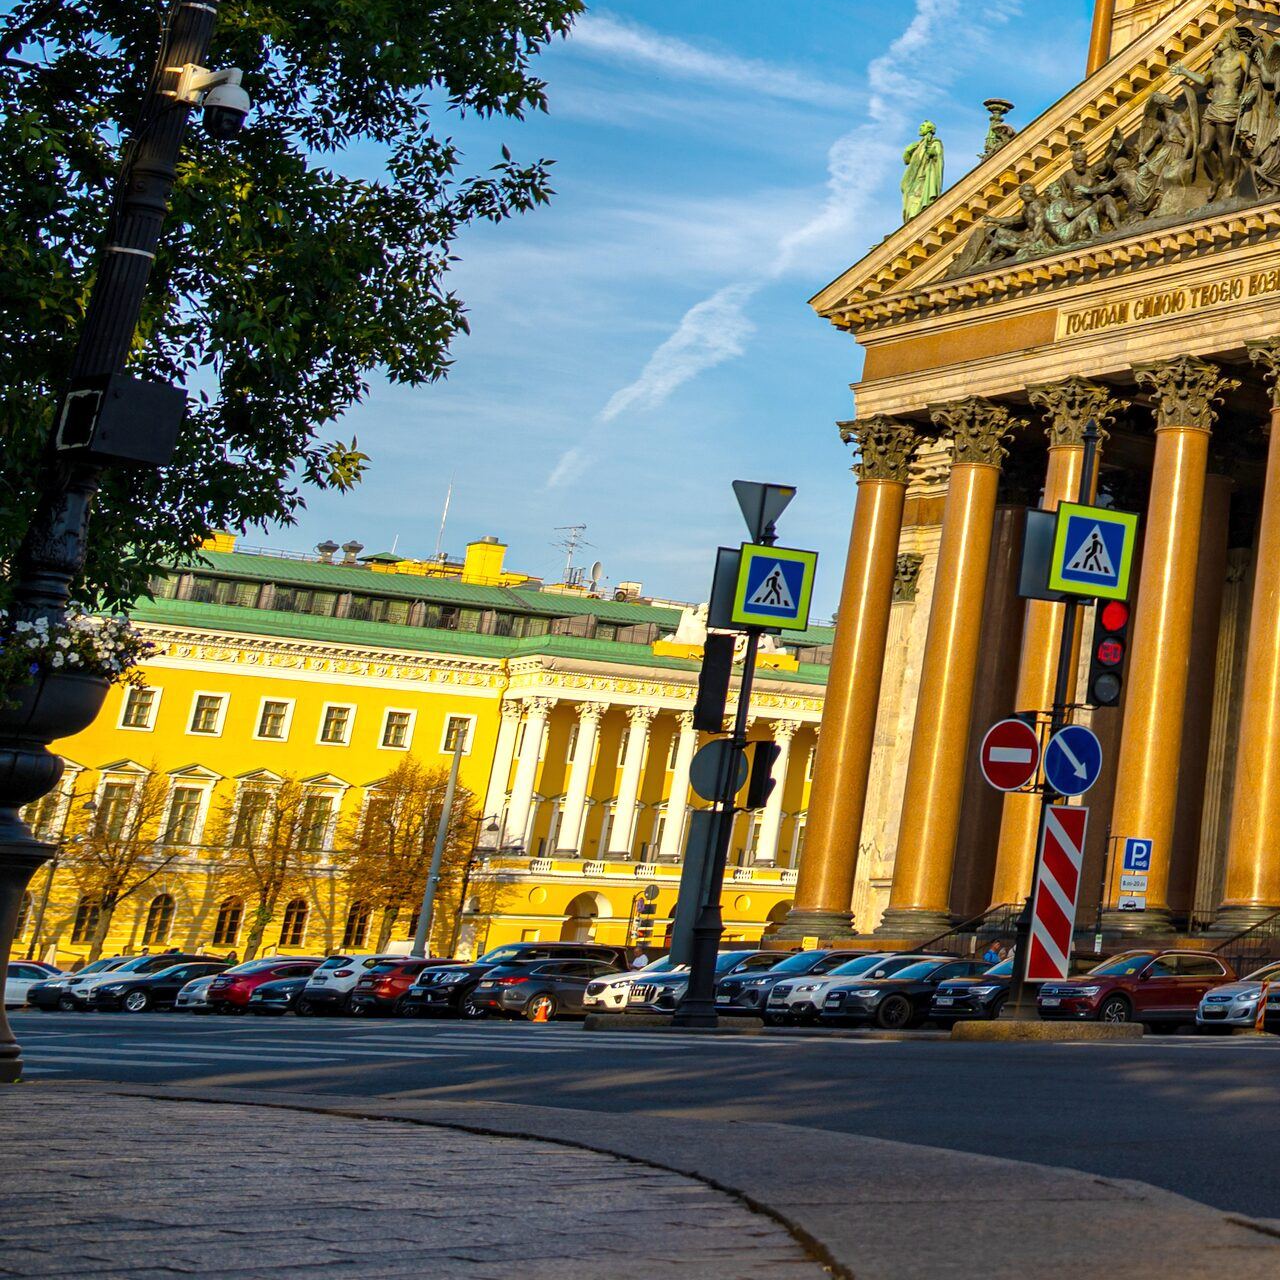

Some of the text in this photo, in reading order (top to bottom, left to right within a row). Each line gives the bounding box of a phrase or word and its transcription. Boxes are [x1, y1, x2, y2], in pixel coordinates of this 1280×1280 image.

[1066, 303, 1129, 335] ГОСПОДИ
[1133, 291, 1185, 320] СИЛОЮ
[1131, 842, 1147, 867] P
